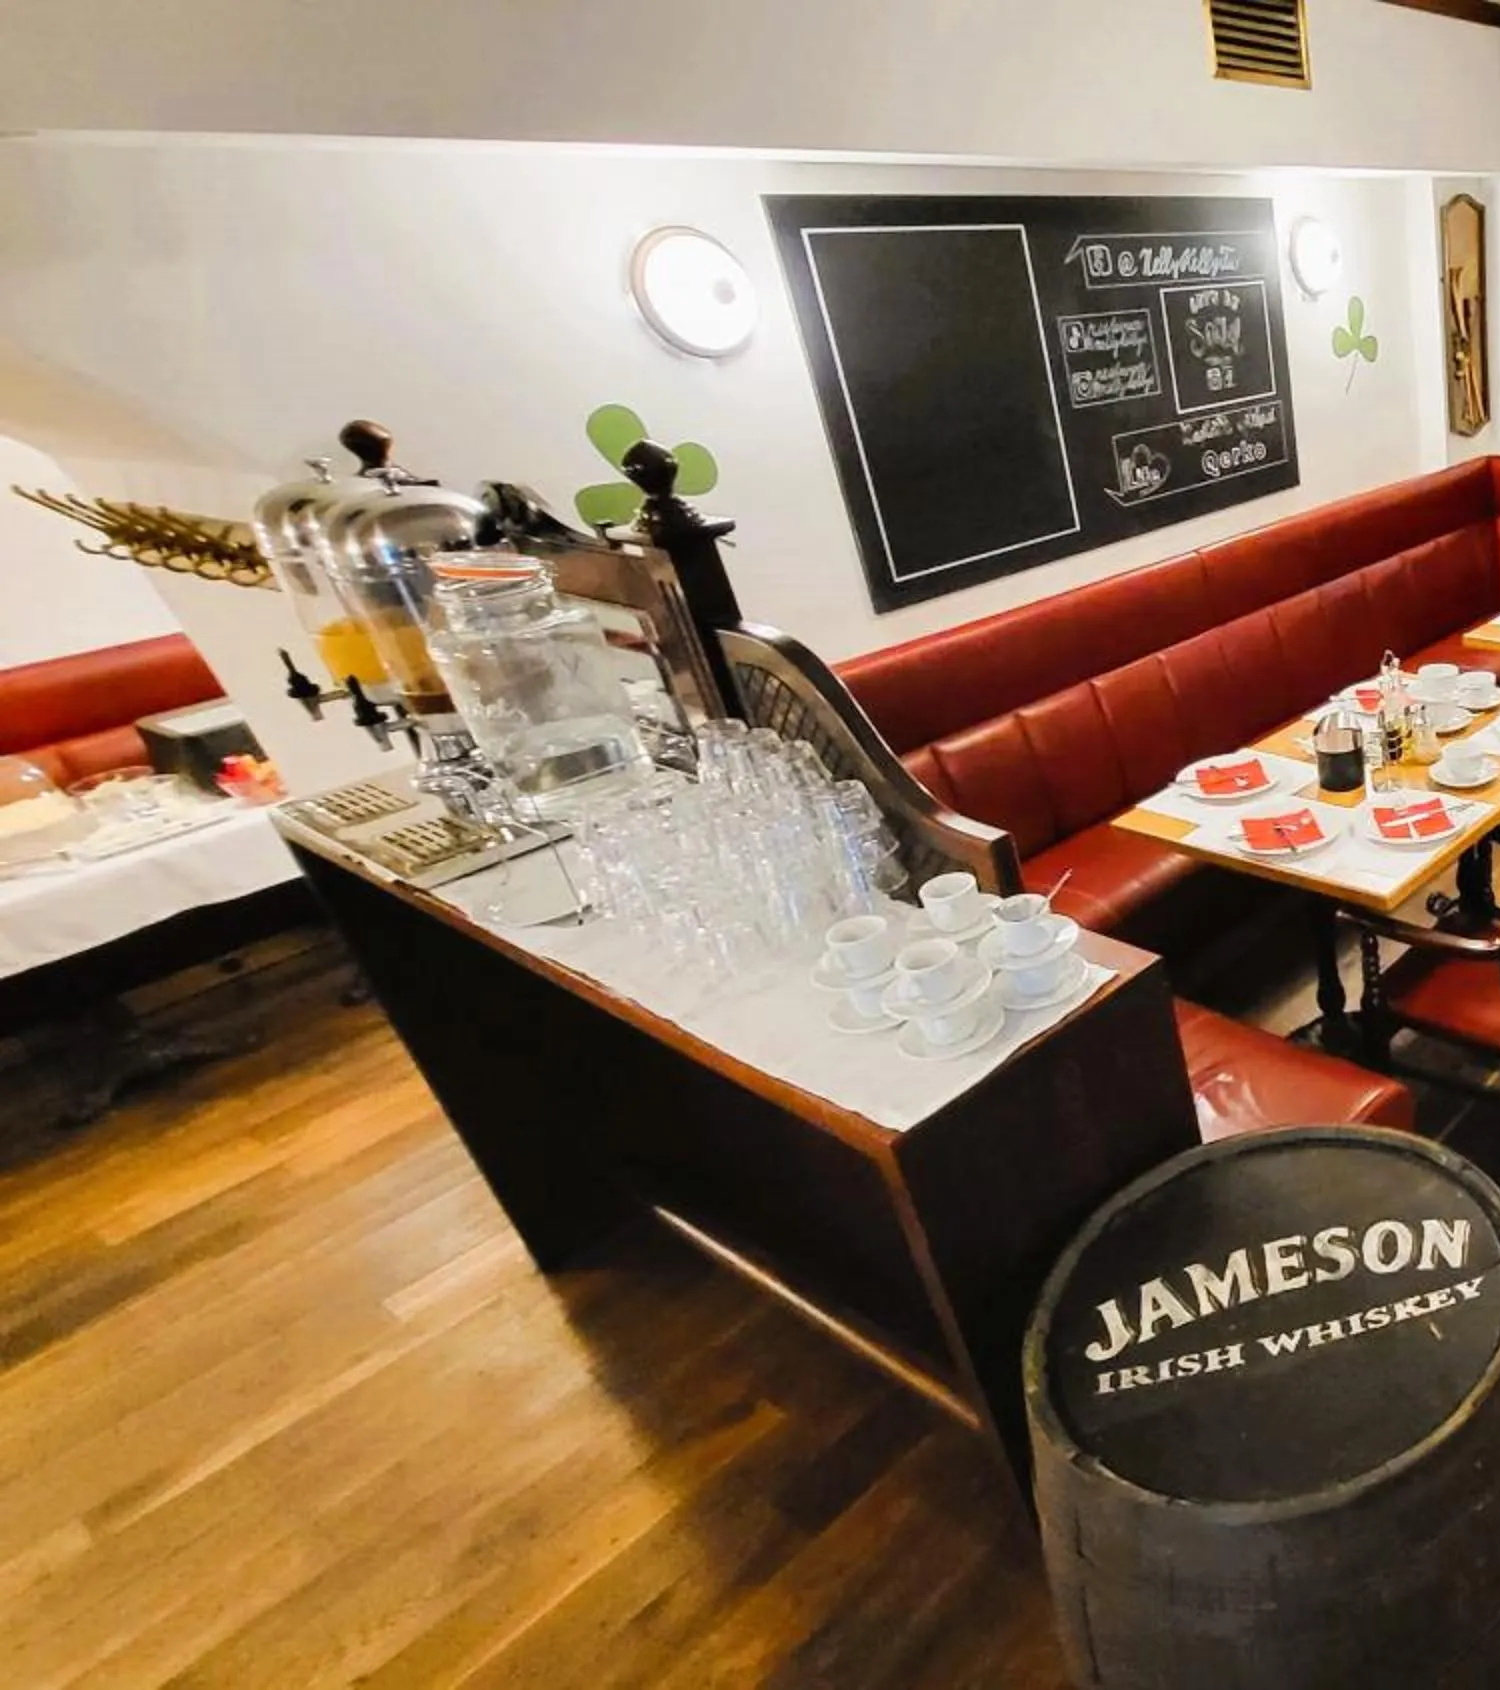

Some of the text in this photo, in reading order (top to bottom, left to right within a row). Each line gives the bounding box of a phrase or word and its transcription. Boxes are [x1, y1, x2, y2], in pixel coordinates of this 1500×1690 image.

[1085, 1219, 1471, 1362] JAMESON
[1095, 1276, 1486, 1394] IRISH WHISKEY
